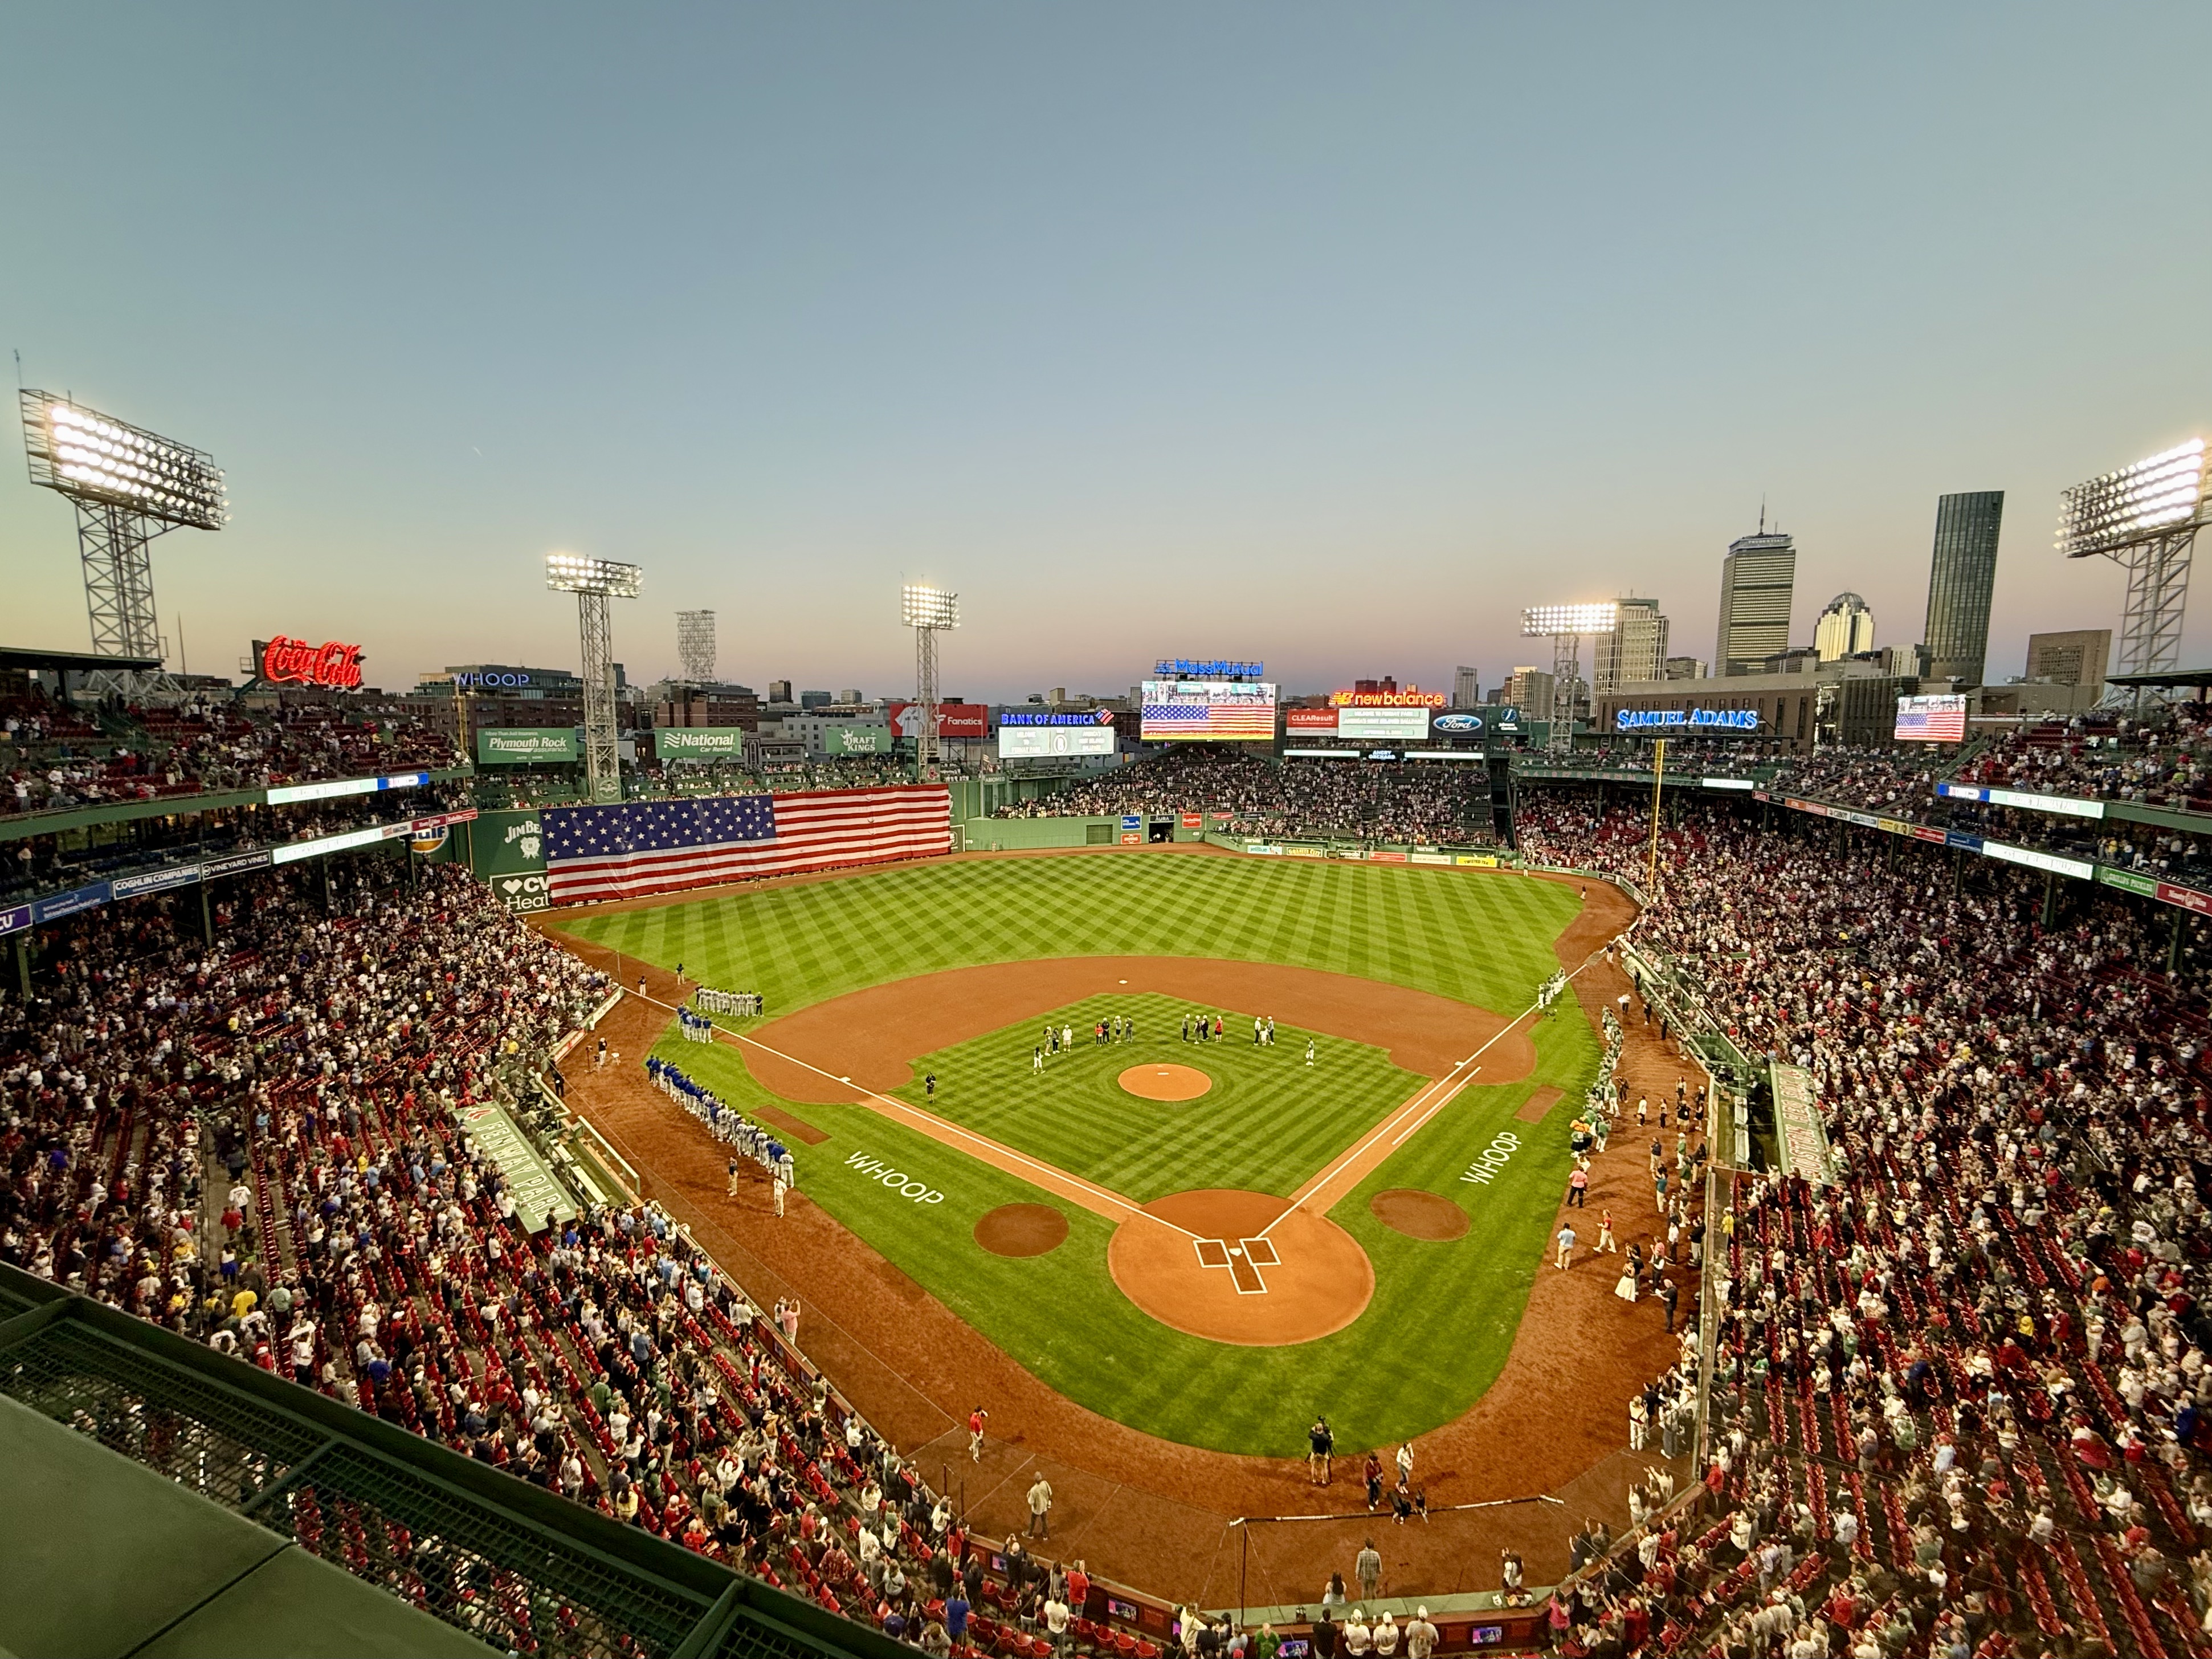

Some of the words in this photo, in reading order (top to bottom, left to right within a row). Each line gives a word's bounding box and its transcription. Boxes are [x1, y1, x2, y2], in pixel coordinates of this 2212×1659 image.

[1175, 658, 1263, 676] MassMutual
[452, 672, 529, 686] WHOOP
[947, 717, 982, 725] Fanatics
[1001, 714, 1032, 725] BANK
[1035, 714, 1048, 725] OF
[1050, 714, 1095, 725] AMERICA
[1442, 717, 1472, 729] Ford
[1617, 710, 1687, 729] SAMUEL
[1688, 708, 1758, 729] ADAMS
[489, 737, 539, 749] Plymouth
[541, 737, 568, 747] Rock
[681, 733, 734, 747] National
[843, 736, 876, 745] DRAFT
[504, 825, 525, 843] JIM
[525, 820, 543, 834] BE
[211, 860, 247, 872] VINEYARD
[248, 855, 268, 864] VINES
[115, 876, 153, 891] COGHLIN
[153, 866, 199, 883] COMPANIES
[524, 876, 551, 892] CV
[505, 892, 550, 910] Heal
[1459, 1131, 1522, 1185] WHOOP
[475, 1120, 538, 1177] FENWAY
[513, 1173, 571, 1224] PARK
[844, 1151, 944, 1204] WHOOP
